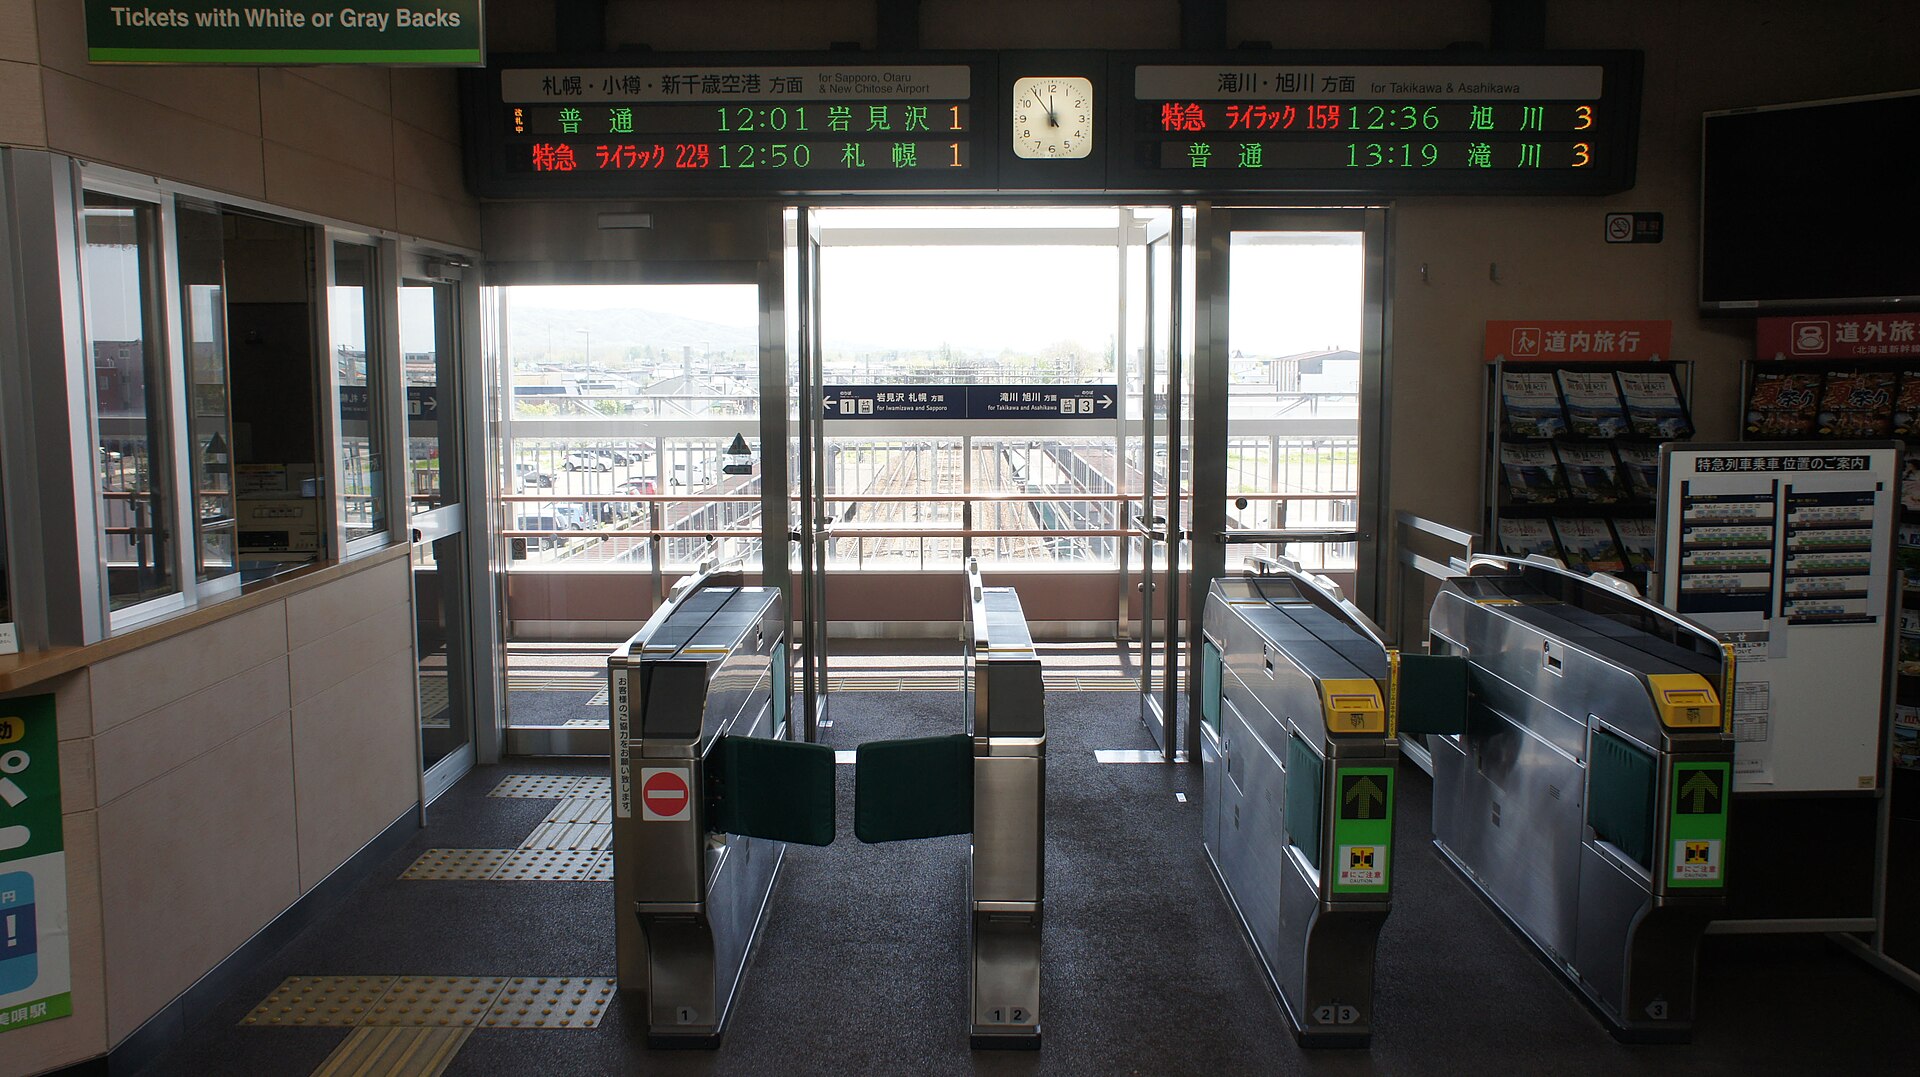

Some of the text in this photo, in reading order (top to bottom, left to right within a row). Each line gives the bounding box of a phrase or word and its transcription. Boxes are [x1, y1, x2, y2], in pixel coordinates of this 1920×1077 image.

[112, 7, 460, 33] Tickets with White or Gray Backs
[819, 73, 912, 85] for Sapporo, Otaru
[1321, 76, 1356, 93] 方面
[769, 76, 803, 94] 方面
[819, 84, 930, 95] & New Chitose Airport
[1048, 85, 1057, 93] 12
[1371, 83, 1520, 93] for Takikawa & Asahikawa
[1023, 100, 1031, 108] 10
[1075, 100, 1081, 108] 2
[717, 107, 809, 132] 12:01
[949, 106, 962, 130] 1
[1020, 115, 1026, 123] 9
[1079, 115, 1085, 123] 3
[1161, 103, 1207, 131] 特急
[1225, 105, 1296, 129] ライラック
[1306, 105, 1341, 129] 15号
[1348, 106, 1439, 130] 12:36
[1574, 106, 1593, 130] 3
[1024, 130, 1030, 138] 8
[1035, 141, 1041, 149] 7
[1048, 145, 1055, 153] 6
[1064, 141, 1070, 149] 5
[532, 143, 577, 171] 特急
[595, 145, 665, 169] ライラック
[676, 144, 709, 169] 22号
[718, 144, 810, 169] 12:50
[949, 143, 963, 167] 1
[1346, 143, 1438, 167] 13:19
[1571, 143, 1590, 167] 3
[1835, 320, 1920, 343] 道外旅
[1544, 330, 1641, 353] 道内旅行
[877, 393, 905, 402] 岩見沢
[909, 393, 927, 402] 札幌
[1023, 393, 1041, 402] 旭川
[1083, 401, 1090, 412] 3
[1014, 1010, 1022, 1021] 2
[1322, 1009, 1350, 1020] 2 3
[1655, 1004, 1662, 1016] 3
